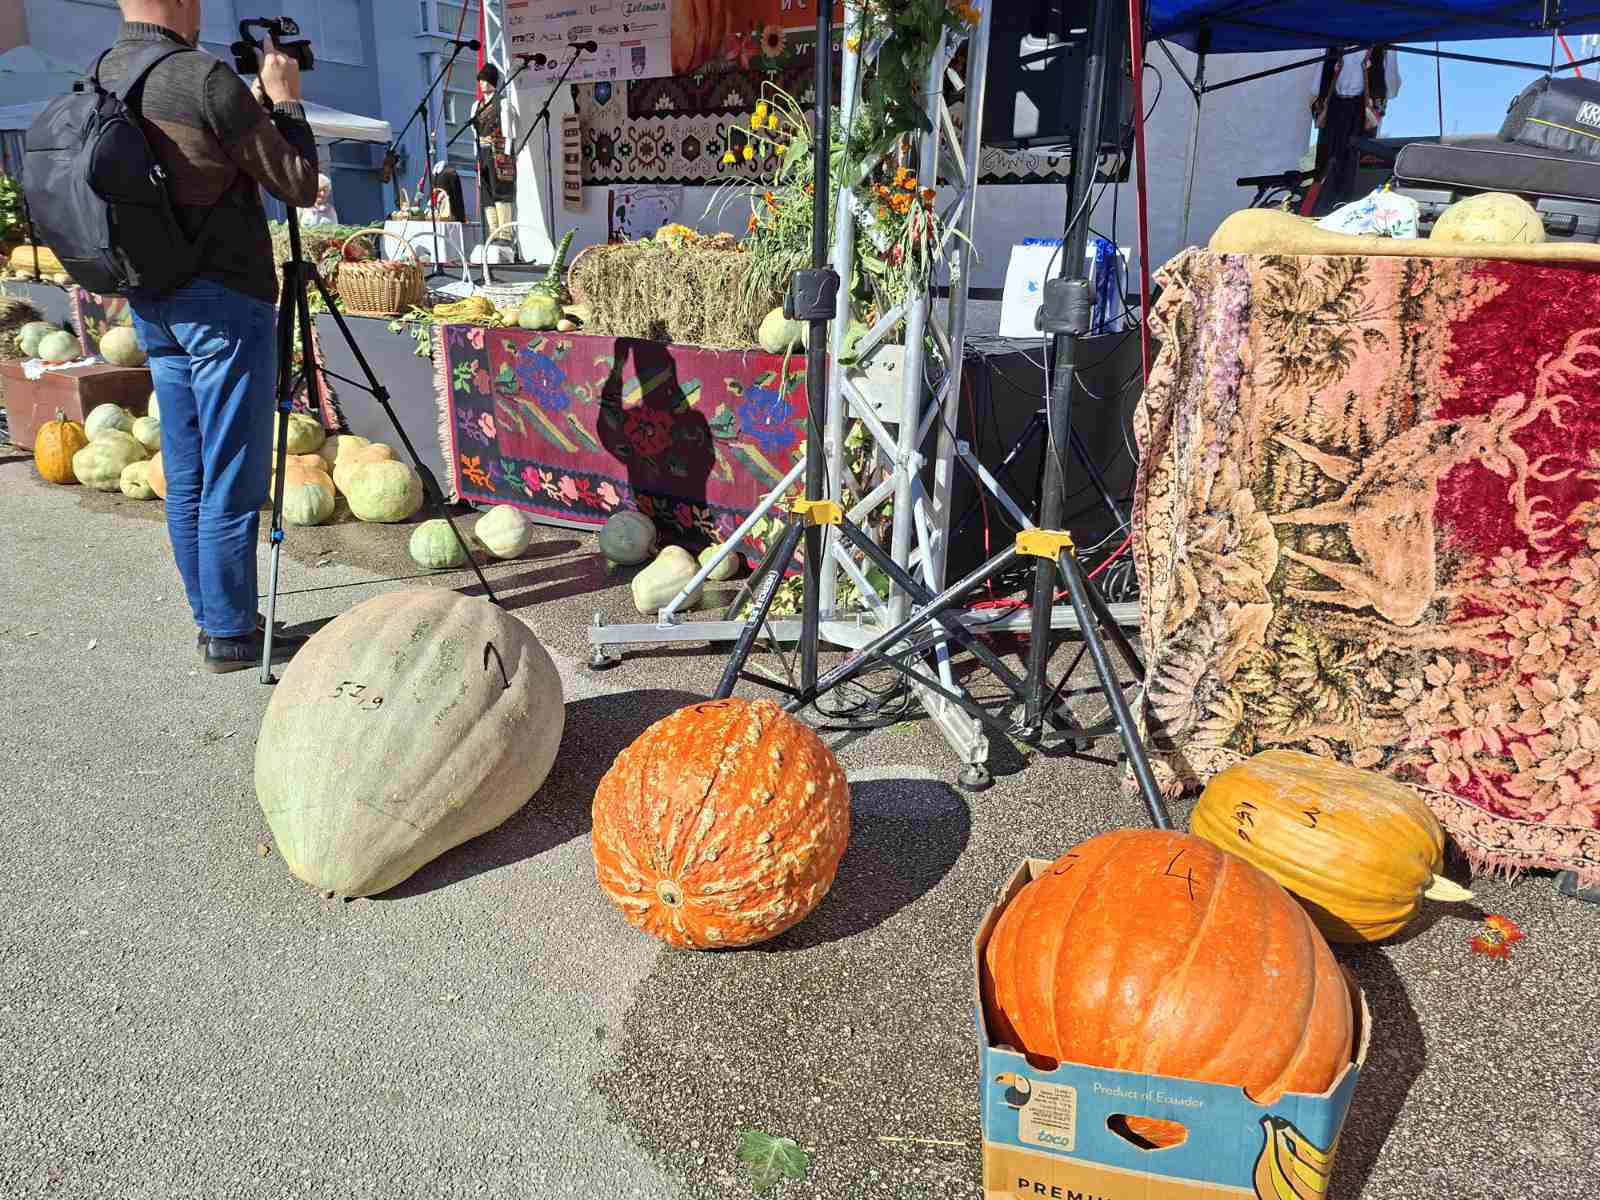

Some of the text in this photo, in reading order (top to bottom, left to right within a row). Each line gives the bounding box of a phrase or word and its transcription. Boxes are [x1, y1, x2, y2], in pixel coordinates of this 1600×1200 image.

[1165, 848, 1201, 901] 4
[1093, 1082, 1203, 1108] Product of Ecuador
[1038, 1130, 1070, 1147] toco
[1018, 1177, 1113, 1200] PREM
